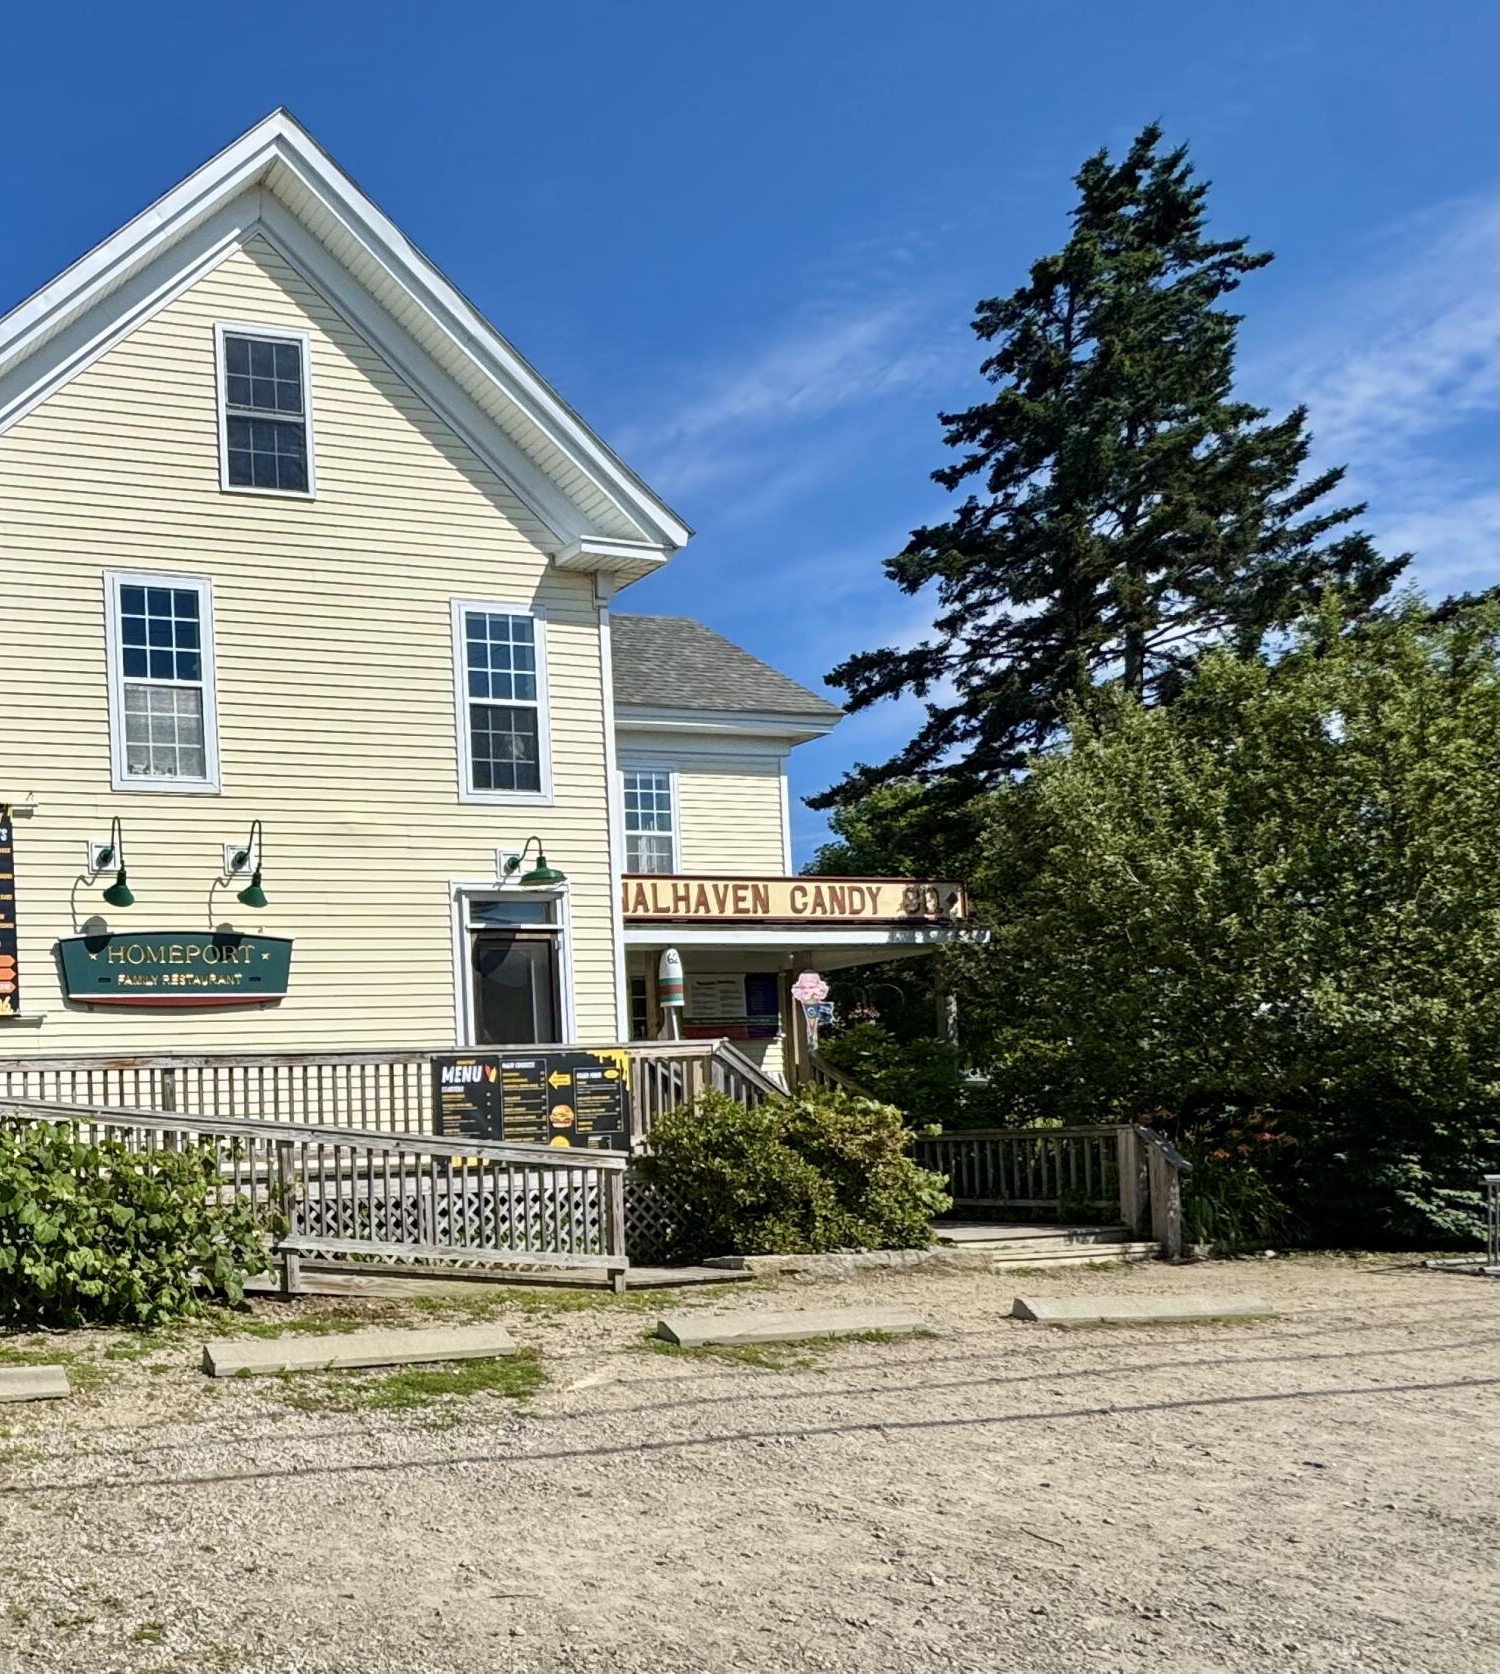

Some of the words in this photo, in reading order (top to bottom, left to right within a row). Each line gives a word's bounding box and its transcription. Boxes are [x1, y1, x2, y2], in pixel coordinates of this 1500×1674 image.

[789, 884, 884, 916] CANDY
[107, 944, 256, 965] HOMEPORT
[117, 974, 159, 986] FAMILY
[162, 973, 243, 987] RESTAURANT
[441, 1065, 482, 1084] MENU
